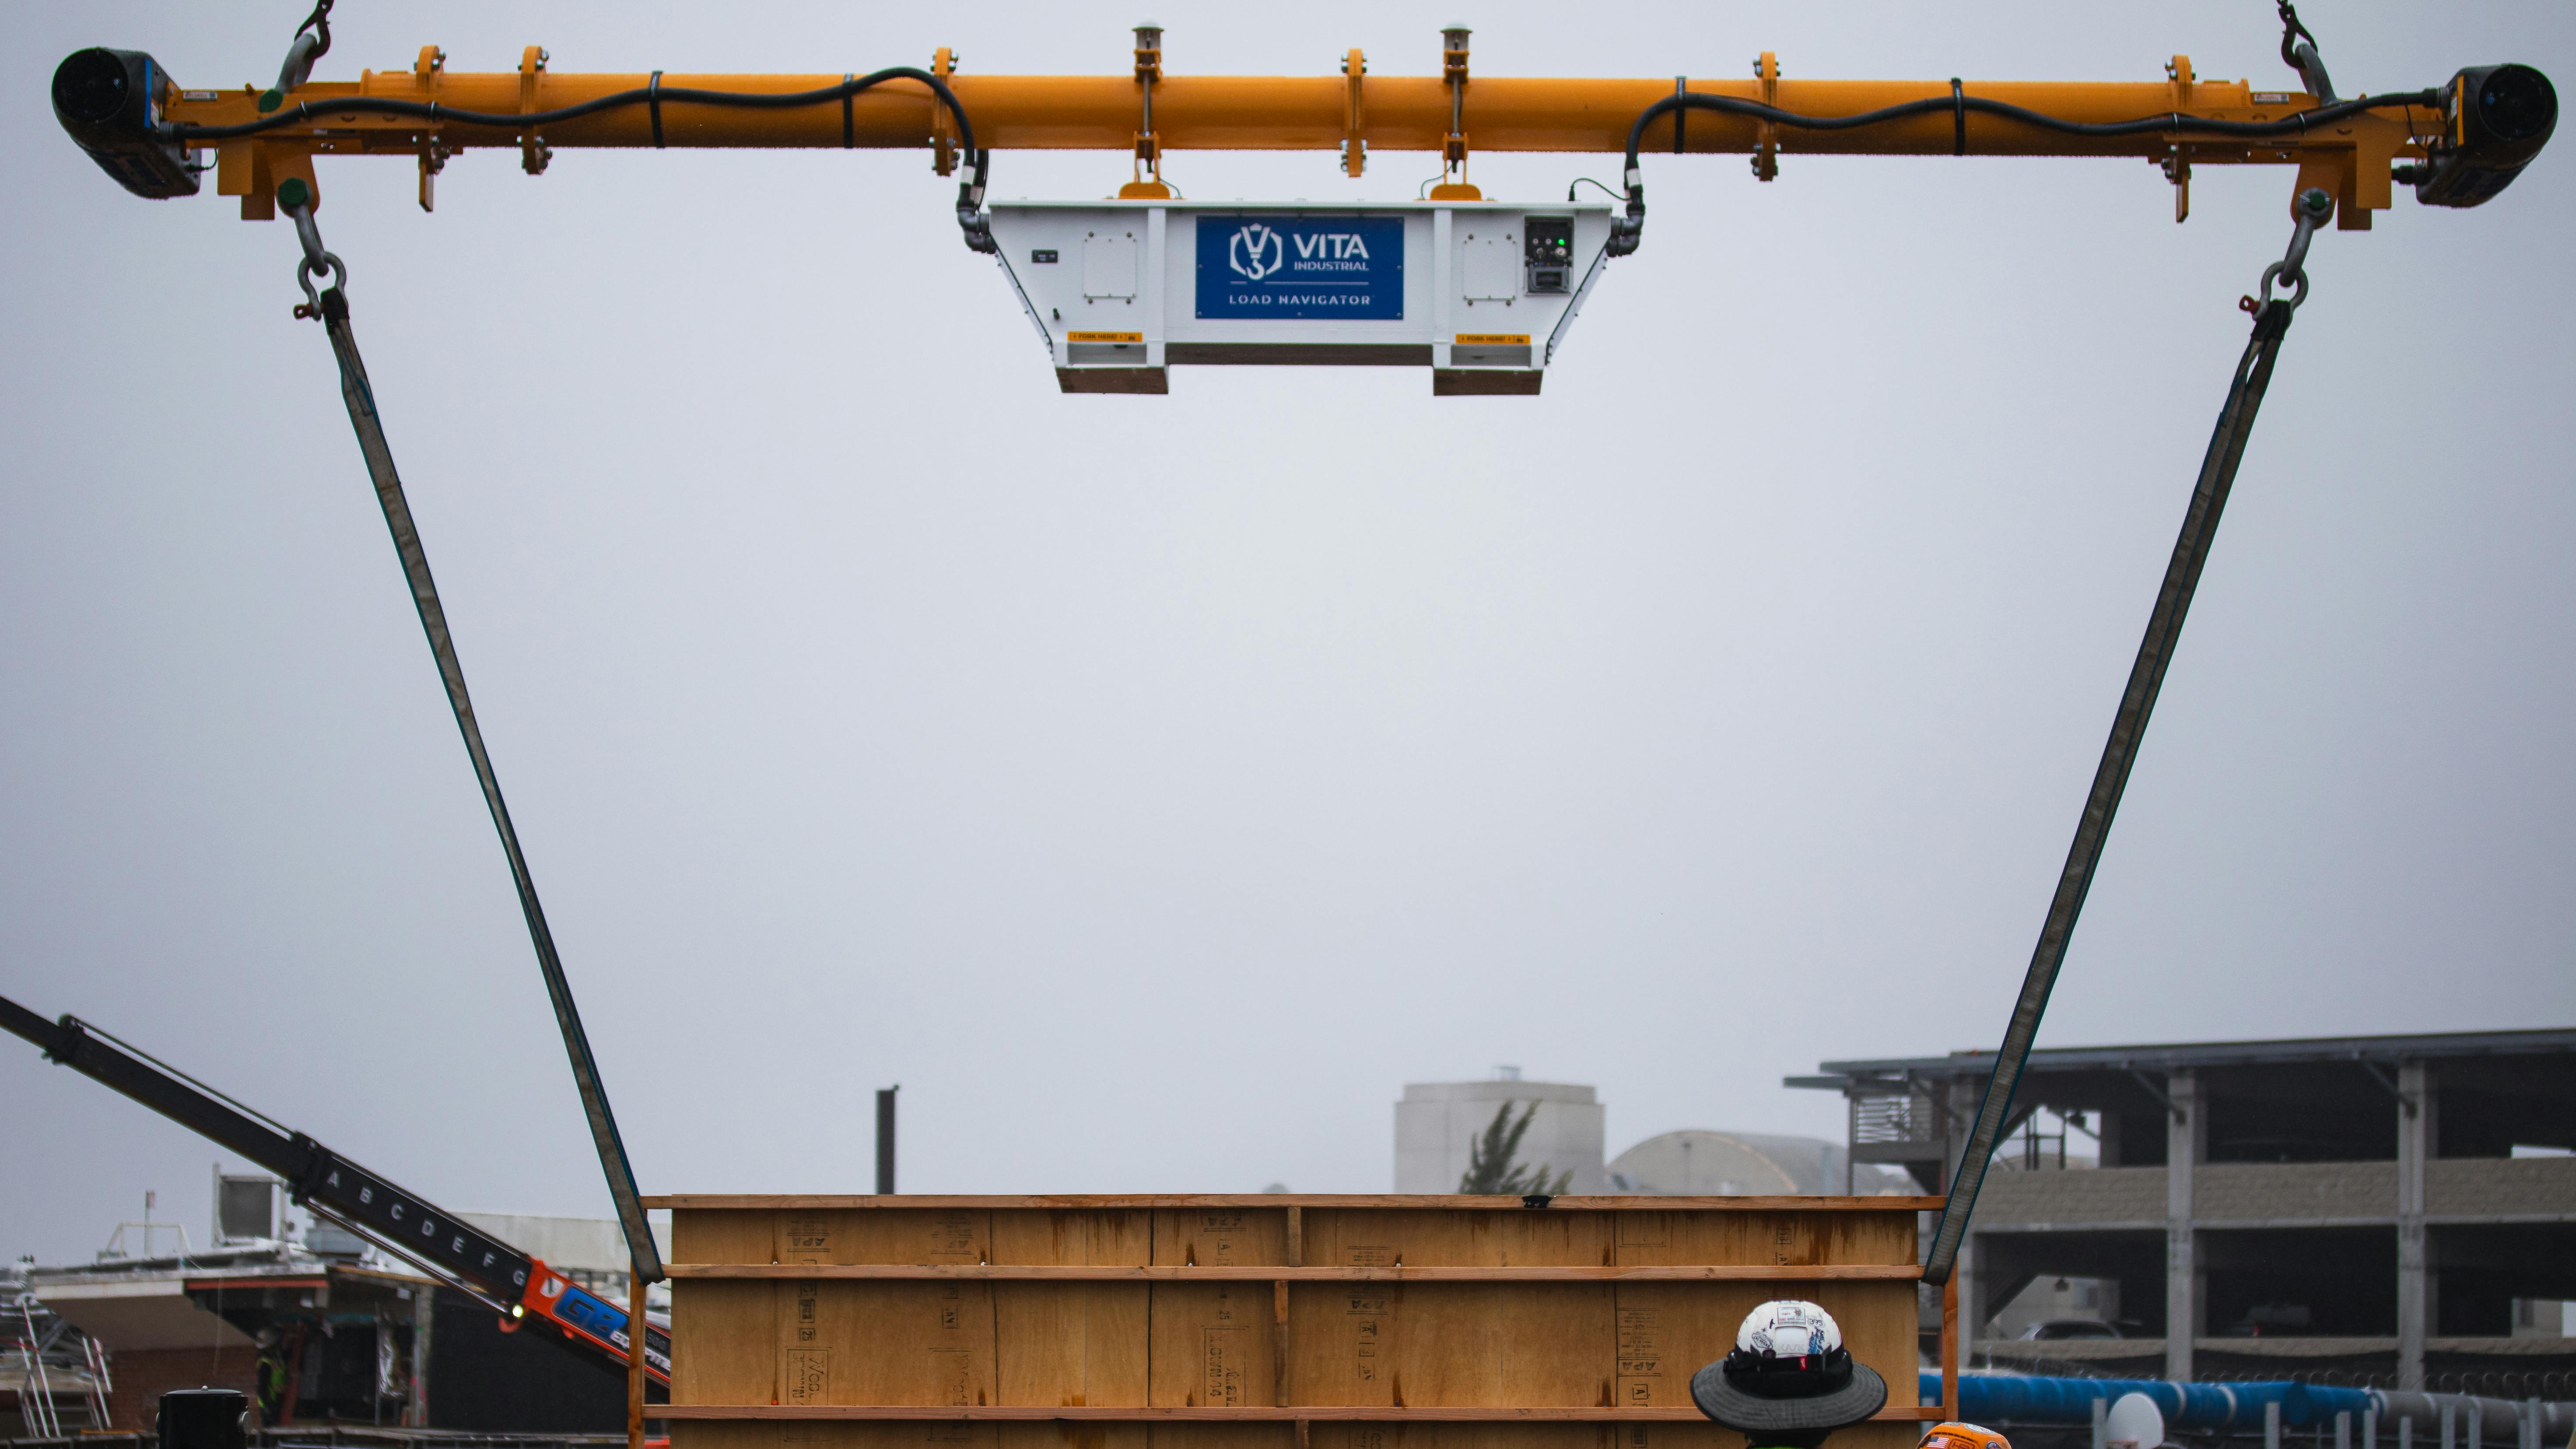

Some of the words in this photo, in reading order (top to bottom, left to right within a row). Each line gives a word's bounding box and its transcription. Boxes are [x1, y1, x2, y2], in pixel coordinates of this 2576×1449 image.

[1293, 234, 1370, 259] VITA
[1294, 262, 1369, 271] INDUSTRIAL
[1229, 295, 1271, 305] LOAD
[1279, 295, 1370, 305] NAVIGATOR
[327, 1171, 340, 1188] A
[360, 1187, 373, 1204] B
[391, 1203, 405, 1220] C
[421, 1220, 435, 1236] D
[452, 1236, 465, 1254] E
[483, 1252, 496, 1268] F
[513, 1269, 525, 1286] G
[1220, 1310, 1230, 1320] 25
[802, 1331, 813, 1341] 25
[1622, 1362, 1657, 1371] APA
